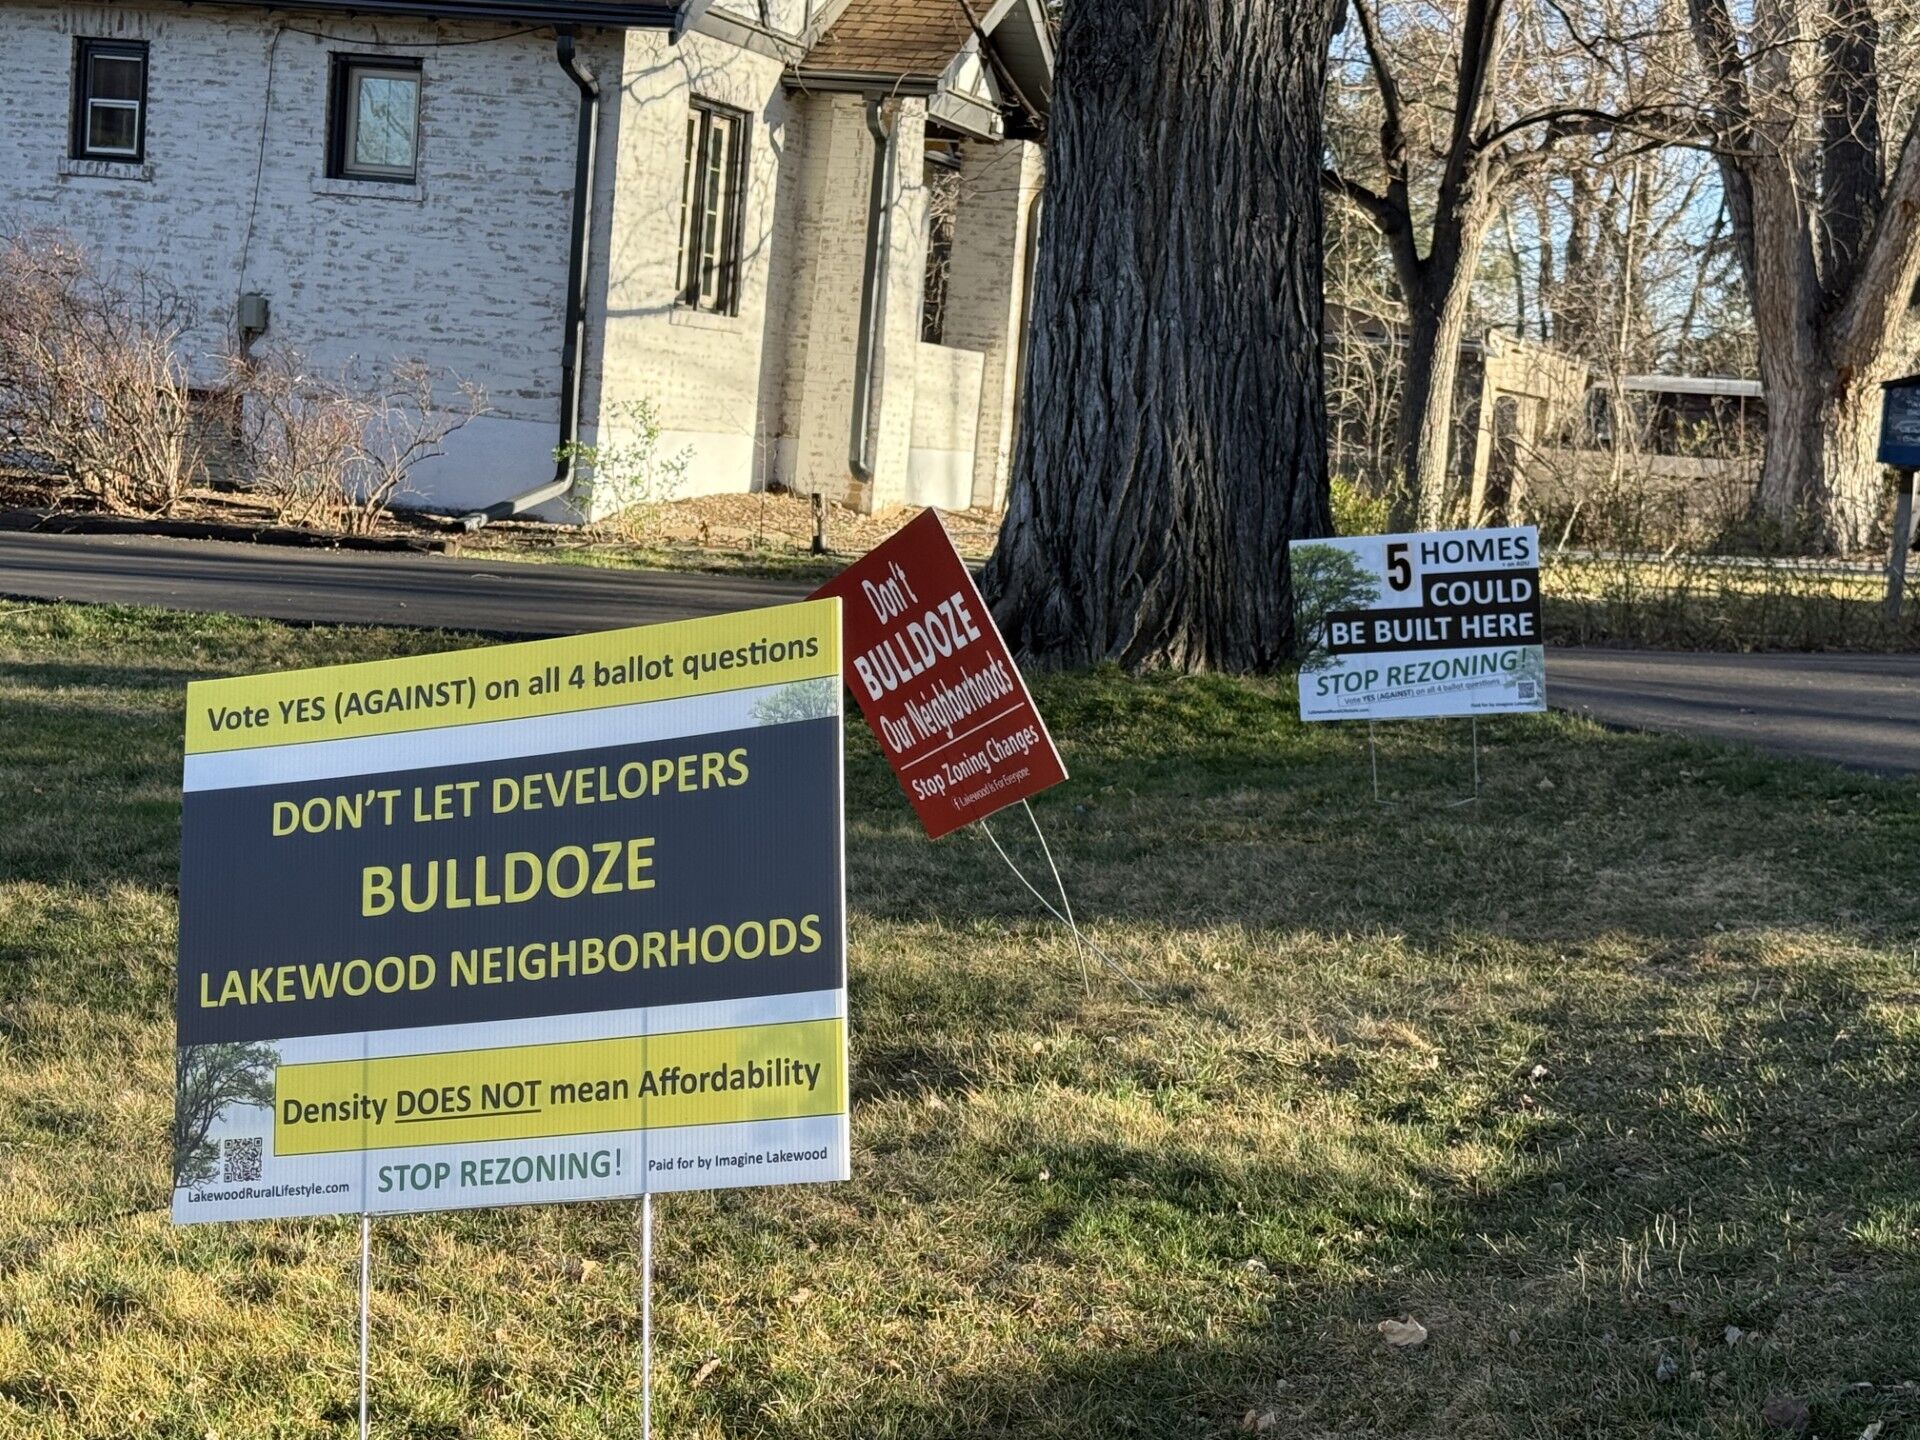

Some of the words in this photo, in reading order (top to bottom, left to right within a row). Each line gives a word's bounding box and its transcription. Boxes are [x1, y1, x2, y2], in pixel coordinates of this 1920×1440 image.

[861, 560, 918, 625] Don't
[1386, 542, 1412, 592] 5
[1421, 536, 1530, 565] HOMES
[1430, 578, 1532, 607] COULD
[853, 591, 982, 701] BULLDOZE
[1331, 621, 1366, 646] BE
[1374, 616, 1452, 644] BUILT
[1460, 612, 1535, 639] HERE
[207, 706, 270, 732] Vote
[278, 697, 326, 724] YES
[335, 676, 476, 724] (AGAINST)
[485, 679, 519, 701] on
[528, 667, 560, 696] all
[568, 664, 586, 689] 4
[594, 654, 673, 688] ballot
[682, 636, 819, 680] questions
[880, 715, 916, 753] Our
[904, 650, 1014, 740] Neighborhoods
[1316, 669, 1379, 697] STOP
[1387, 648, 1527, 687] REZONING!
[1362, 694, 1376, 702] YES
[414, 781, 480, 822] LET
[492, 748, 750, 814] DEVELOPERS
[912, 772, 946, 801] Stop
[942, 752, 992, 786] Zoning
[986, 724, 1040, 763] Changes
[362, 837, 656, 917] BULLDOZE
[200, 954, 436, 1008] LAKEWOOD
[450, 914, 822, 987] NEIGHBORHOODS
[283, 1092, 388, 1125] Density
[396, 1085, 471, 1117] DOES
[481, 1080, 542, 1110] NOT
[550, 1078, 628, 1105] mean
[638, 1058, 821, 1098] Affordability
[378, 1162, 450, 1193] STOP
[460, 1148, 622, 1188] REZONING!
[648, 1158, 674, 1172] Paid
[677, 1157, 694, 1170] for
[698, 1156, 712, 1170] by
[715, 1152, 763, 1168] Imagine
[766, 1147, 828, 1164] Lakewood
[188, 1183, 350, 1203] LakewoodRuralLifestyle.com
